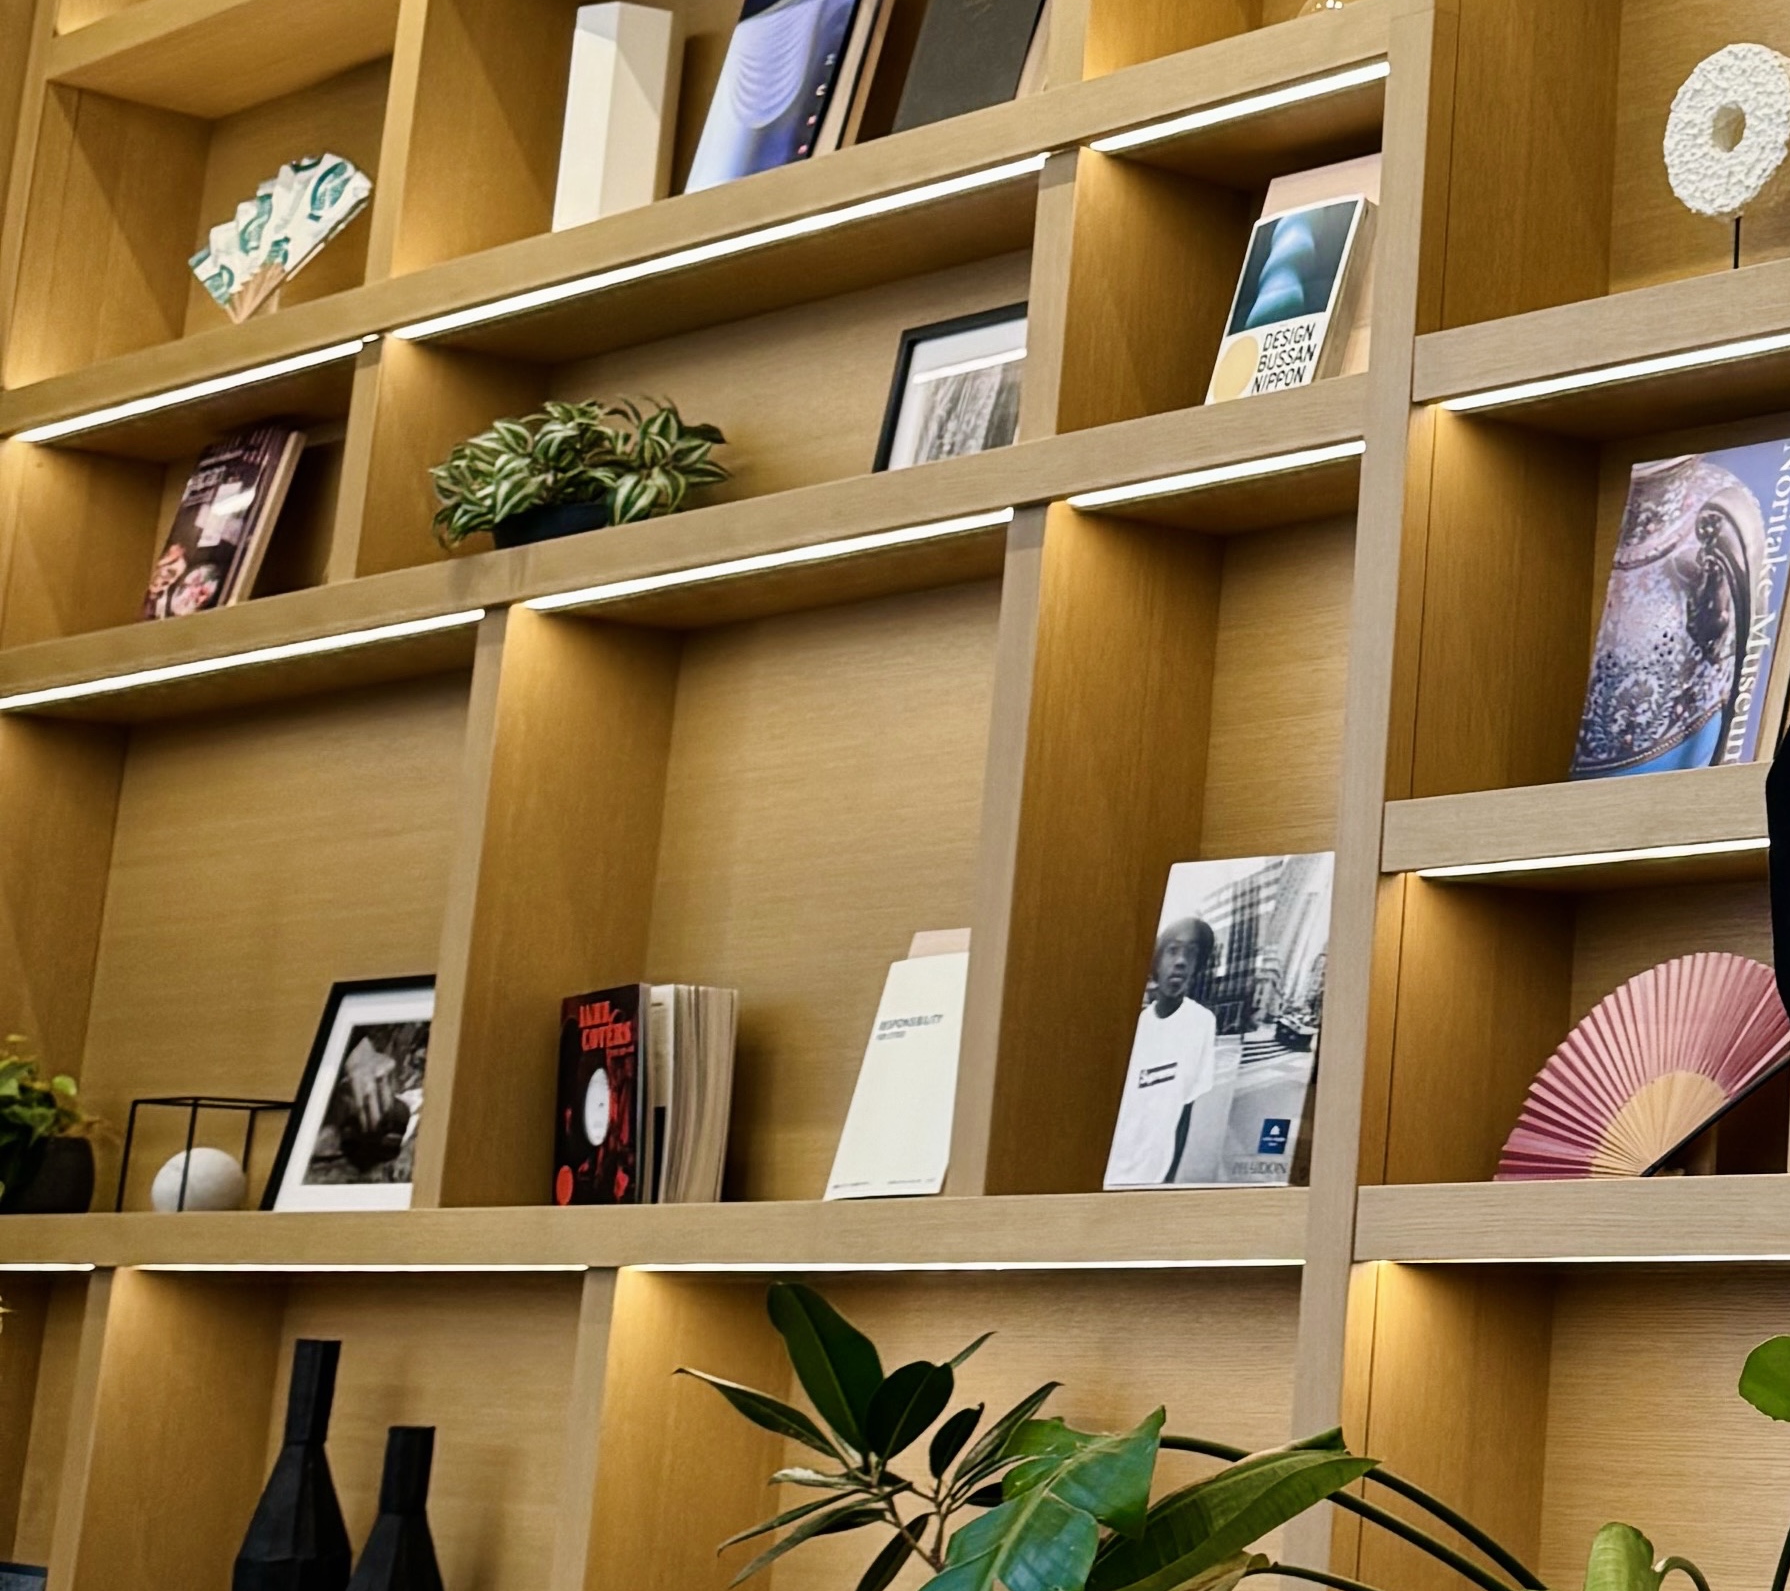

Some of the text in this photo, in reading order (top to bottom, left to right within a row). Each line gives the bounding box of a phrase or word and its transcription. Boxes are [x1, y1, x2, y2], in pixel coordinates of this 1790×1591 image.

[1262, 323, 1316, 352] DESIGN
[1257, 343, 1317, 373] BUSSAN
[1251, 366, 1306, 394] NIPPON
[1723, 612, 1776, 764] Museum
